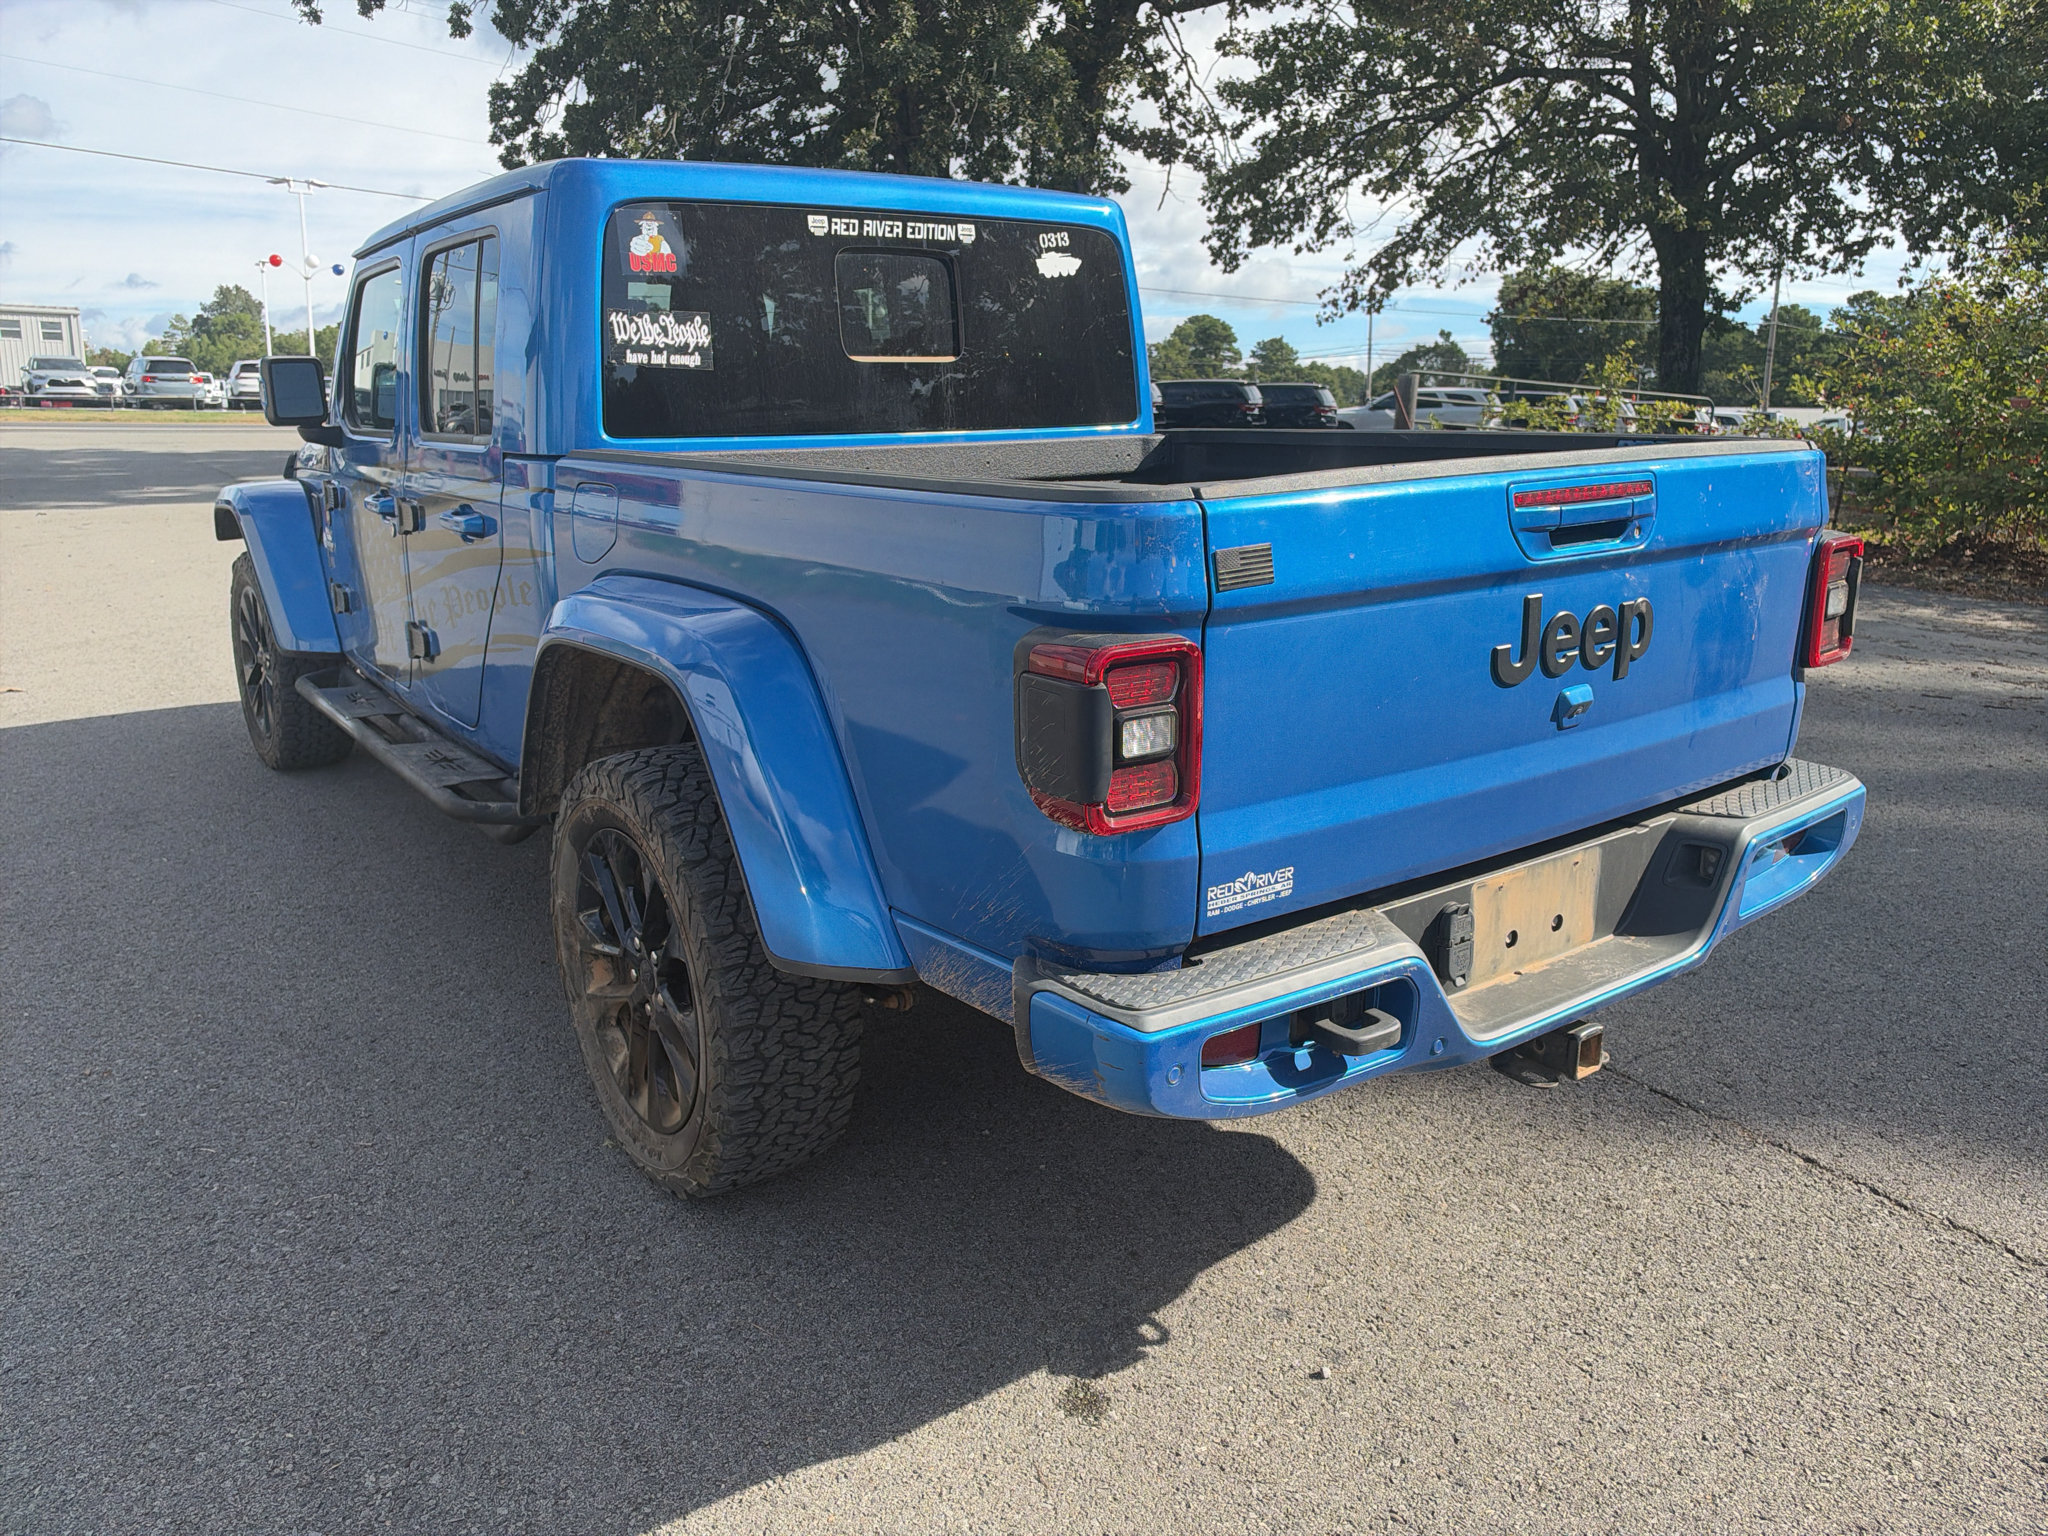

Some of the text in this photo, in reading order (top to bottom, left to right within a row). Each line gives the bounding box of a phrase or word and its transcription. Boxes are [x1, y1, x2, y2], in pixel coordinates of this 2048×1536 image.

[831, 218, 956, 241] RED RIVER EDITION
[1039, 232, 1070, 248] 0313
[629, 252, 677, 272] USMC
[609, 312, 640, 344] We
[659, 313, 711, 352] People
[626, 349, 701, 367] have had enough
[440, 574, 533, 631] People
[1490, 593, 1653, 688] Jeep
[1208, 866, 1294, 901] RED RIVER
[1207, 889, 1293, 918] RAM DODGE CHRYSLER JEEP
